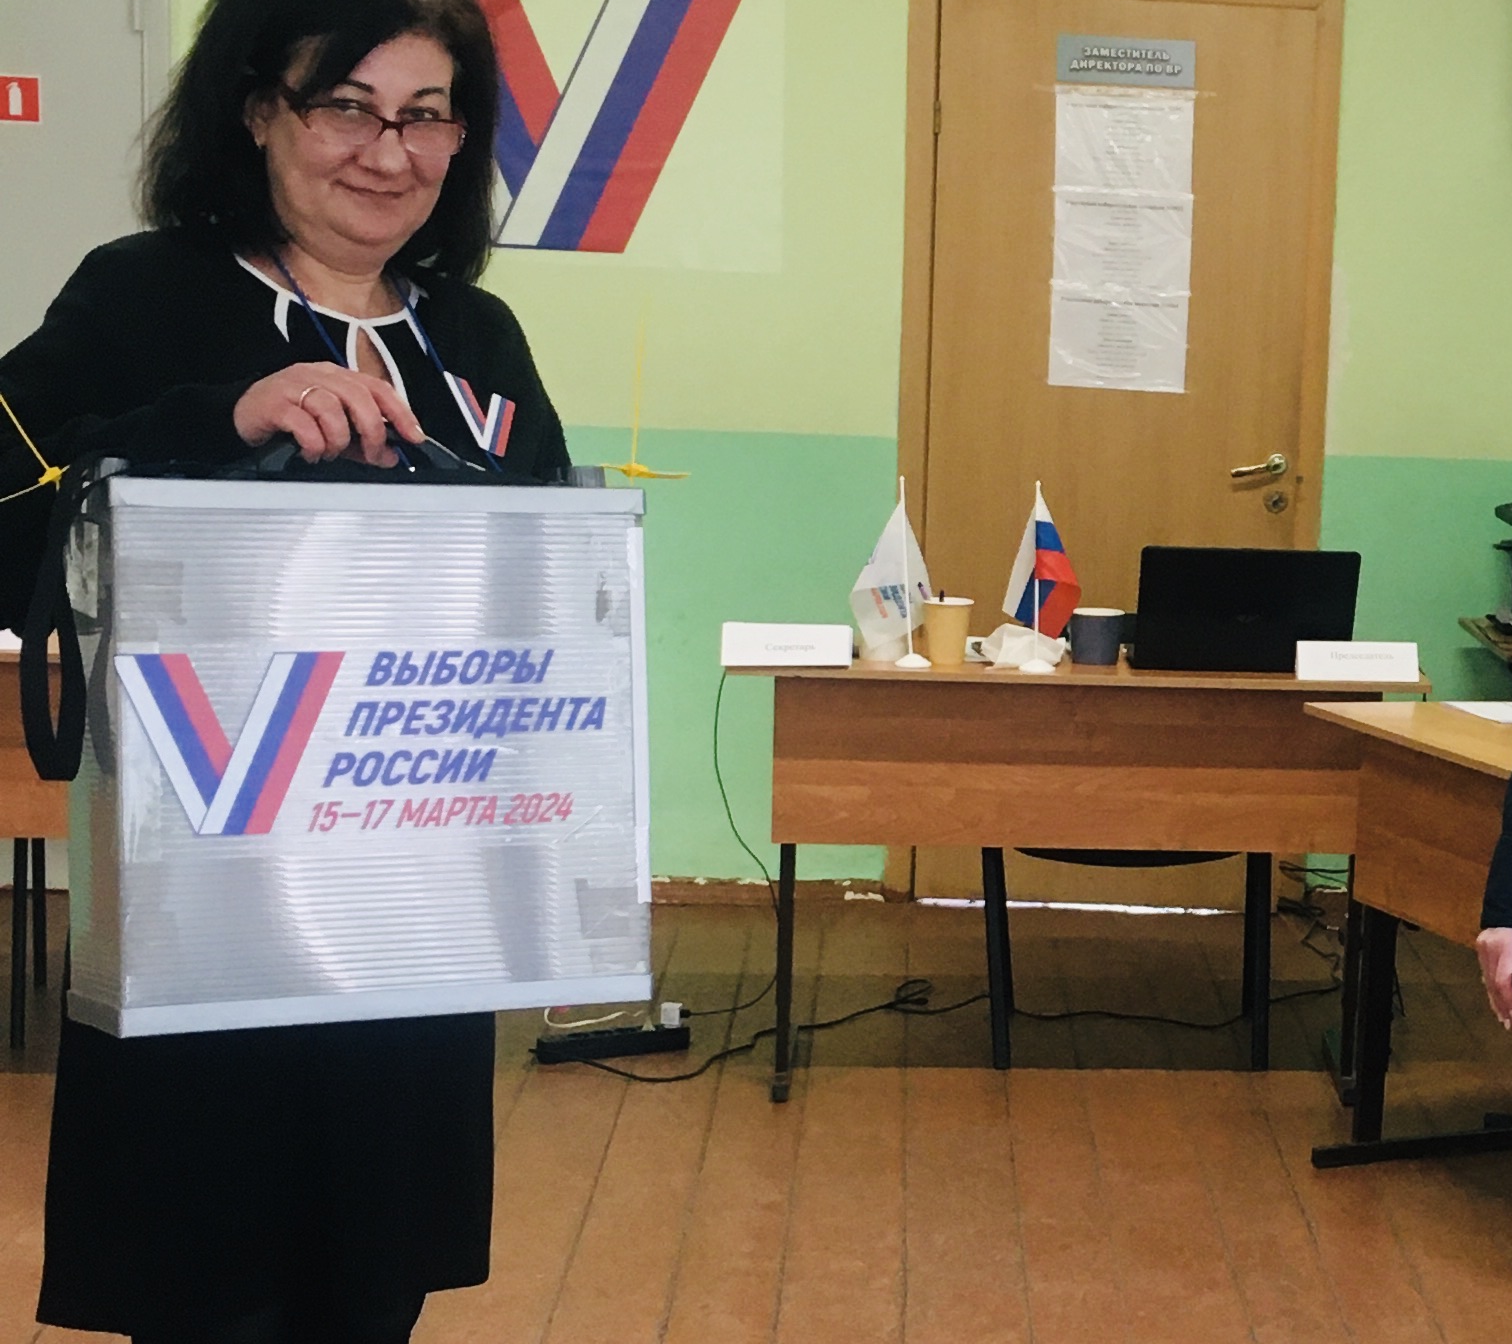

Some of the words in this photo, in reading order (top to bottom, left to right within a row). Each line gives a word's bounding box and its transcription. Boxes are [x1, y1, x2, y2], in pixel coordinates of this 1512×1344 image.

[1069, 59, 1143, 73] ДИРЕКТОРА
[1146, 63, 1163, 74] ПО
[1165, 64, 1182, 75] ВР
[1083, 46, 1171, 61] ЗАМЕСТИТЕЛЬ
[363, 649, 555, 687] ВЫБОРЫ
[343, 696, 607, 740] ПРЕЗИДЕНТА
[322, 748, 499, 788] РОССИИ
[308, 799, 395, 833] 15-17
[396, 794, 497, 829] МАРТА
[503, 792, 575, 825] 2024
